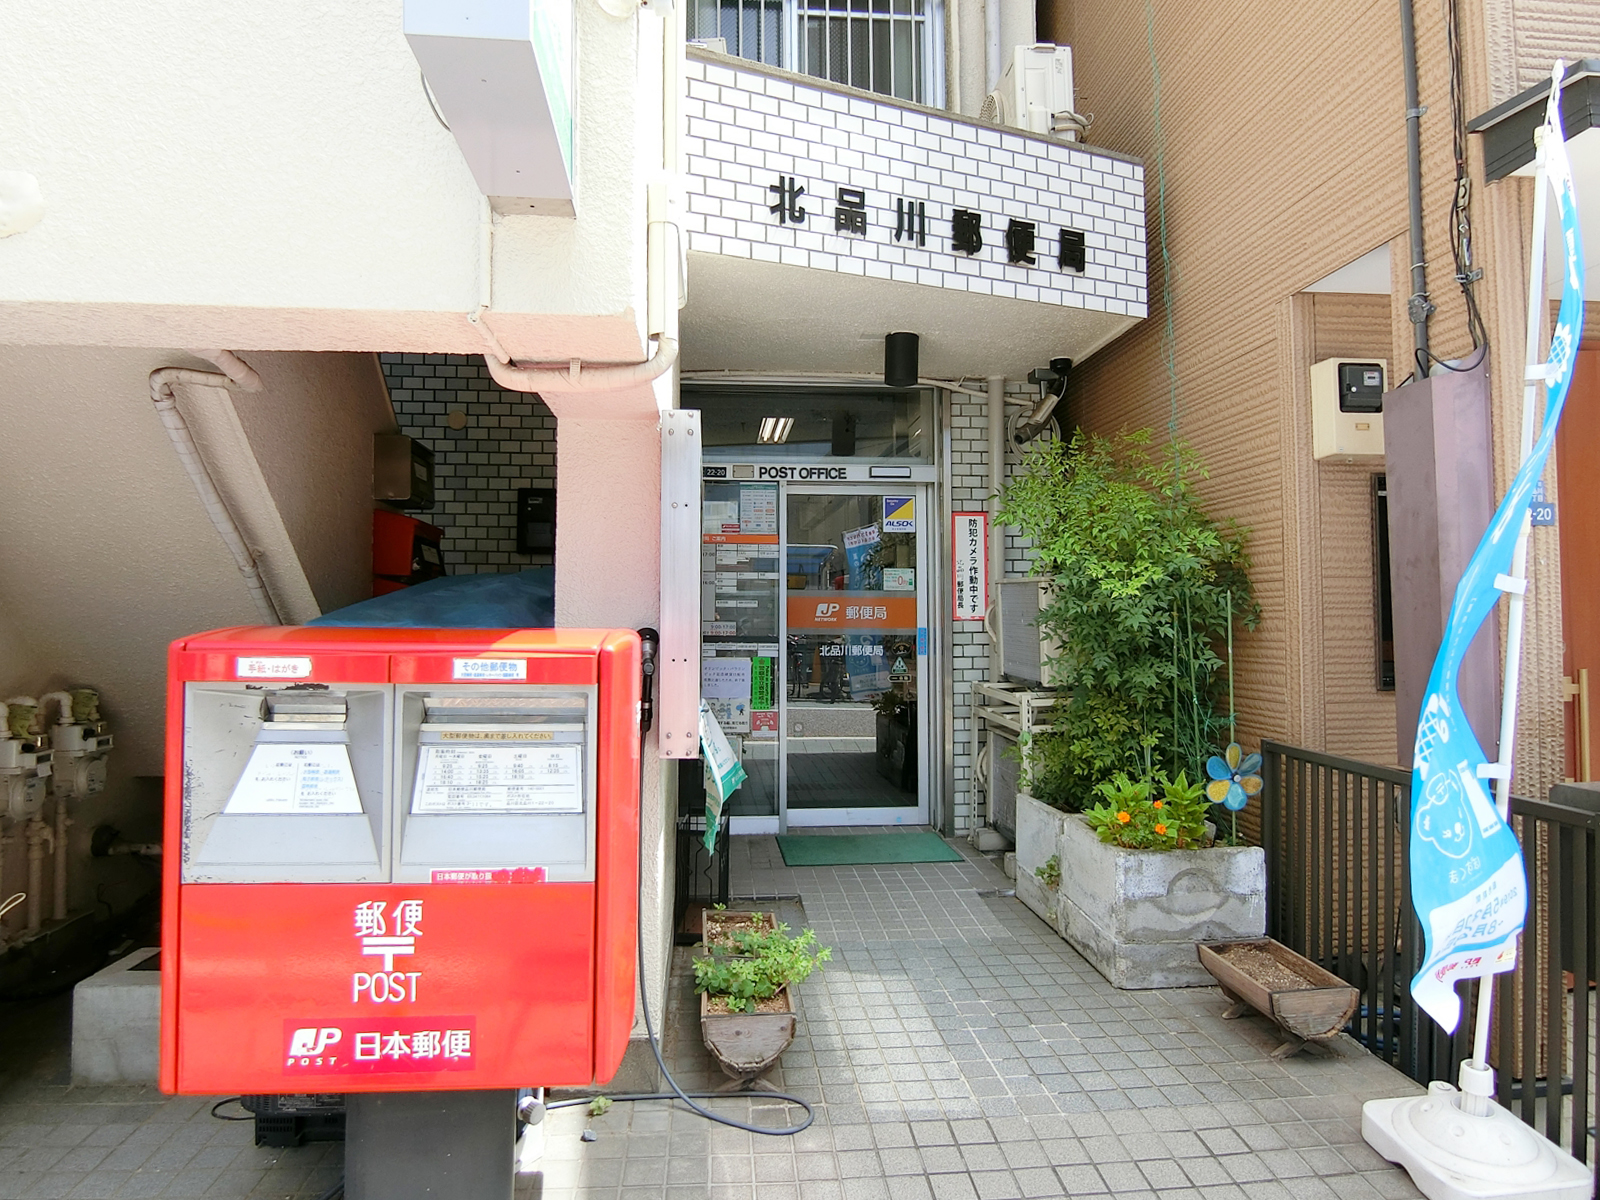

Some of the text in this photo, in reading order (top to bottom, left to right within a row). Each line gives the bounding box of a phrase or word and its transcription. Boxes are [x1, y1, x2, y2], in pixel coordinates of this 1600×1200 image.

[769, 175, 1086, 273] 北品川郵便局
[759, 467, 847, 479] POST OFFICE
[968, 518, 979, 613] 防犯カメラ作動中です
[845, 605, 888, 620] 郵便局
[819, 644, 884, 657] 北品川郵便局
[248, 664, 299, 674] 手紙・はがき
[462, 662, 518, 672] その他郵便物
[354, 899, 424, 936] 郵便
[353, 971, 422, 1003] POST
[354, 1029, 472, 1060] 日本郵便
[287, 1056, 338, 1066] POST
